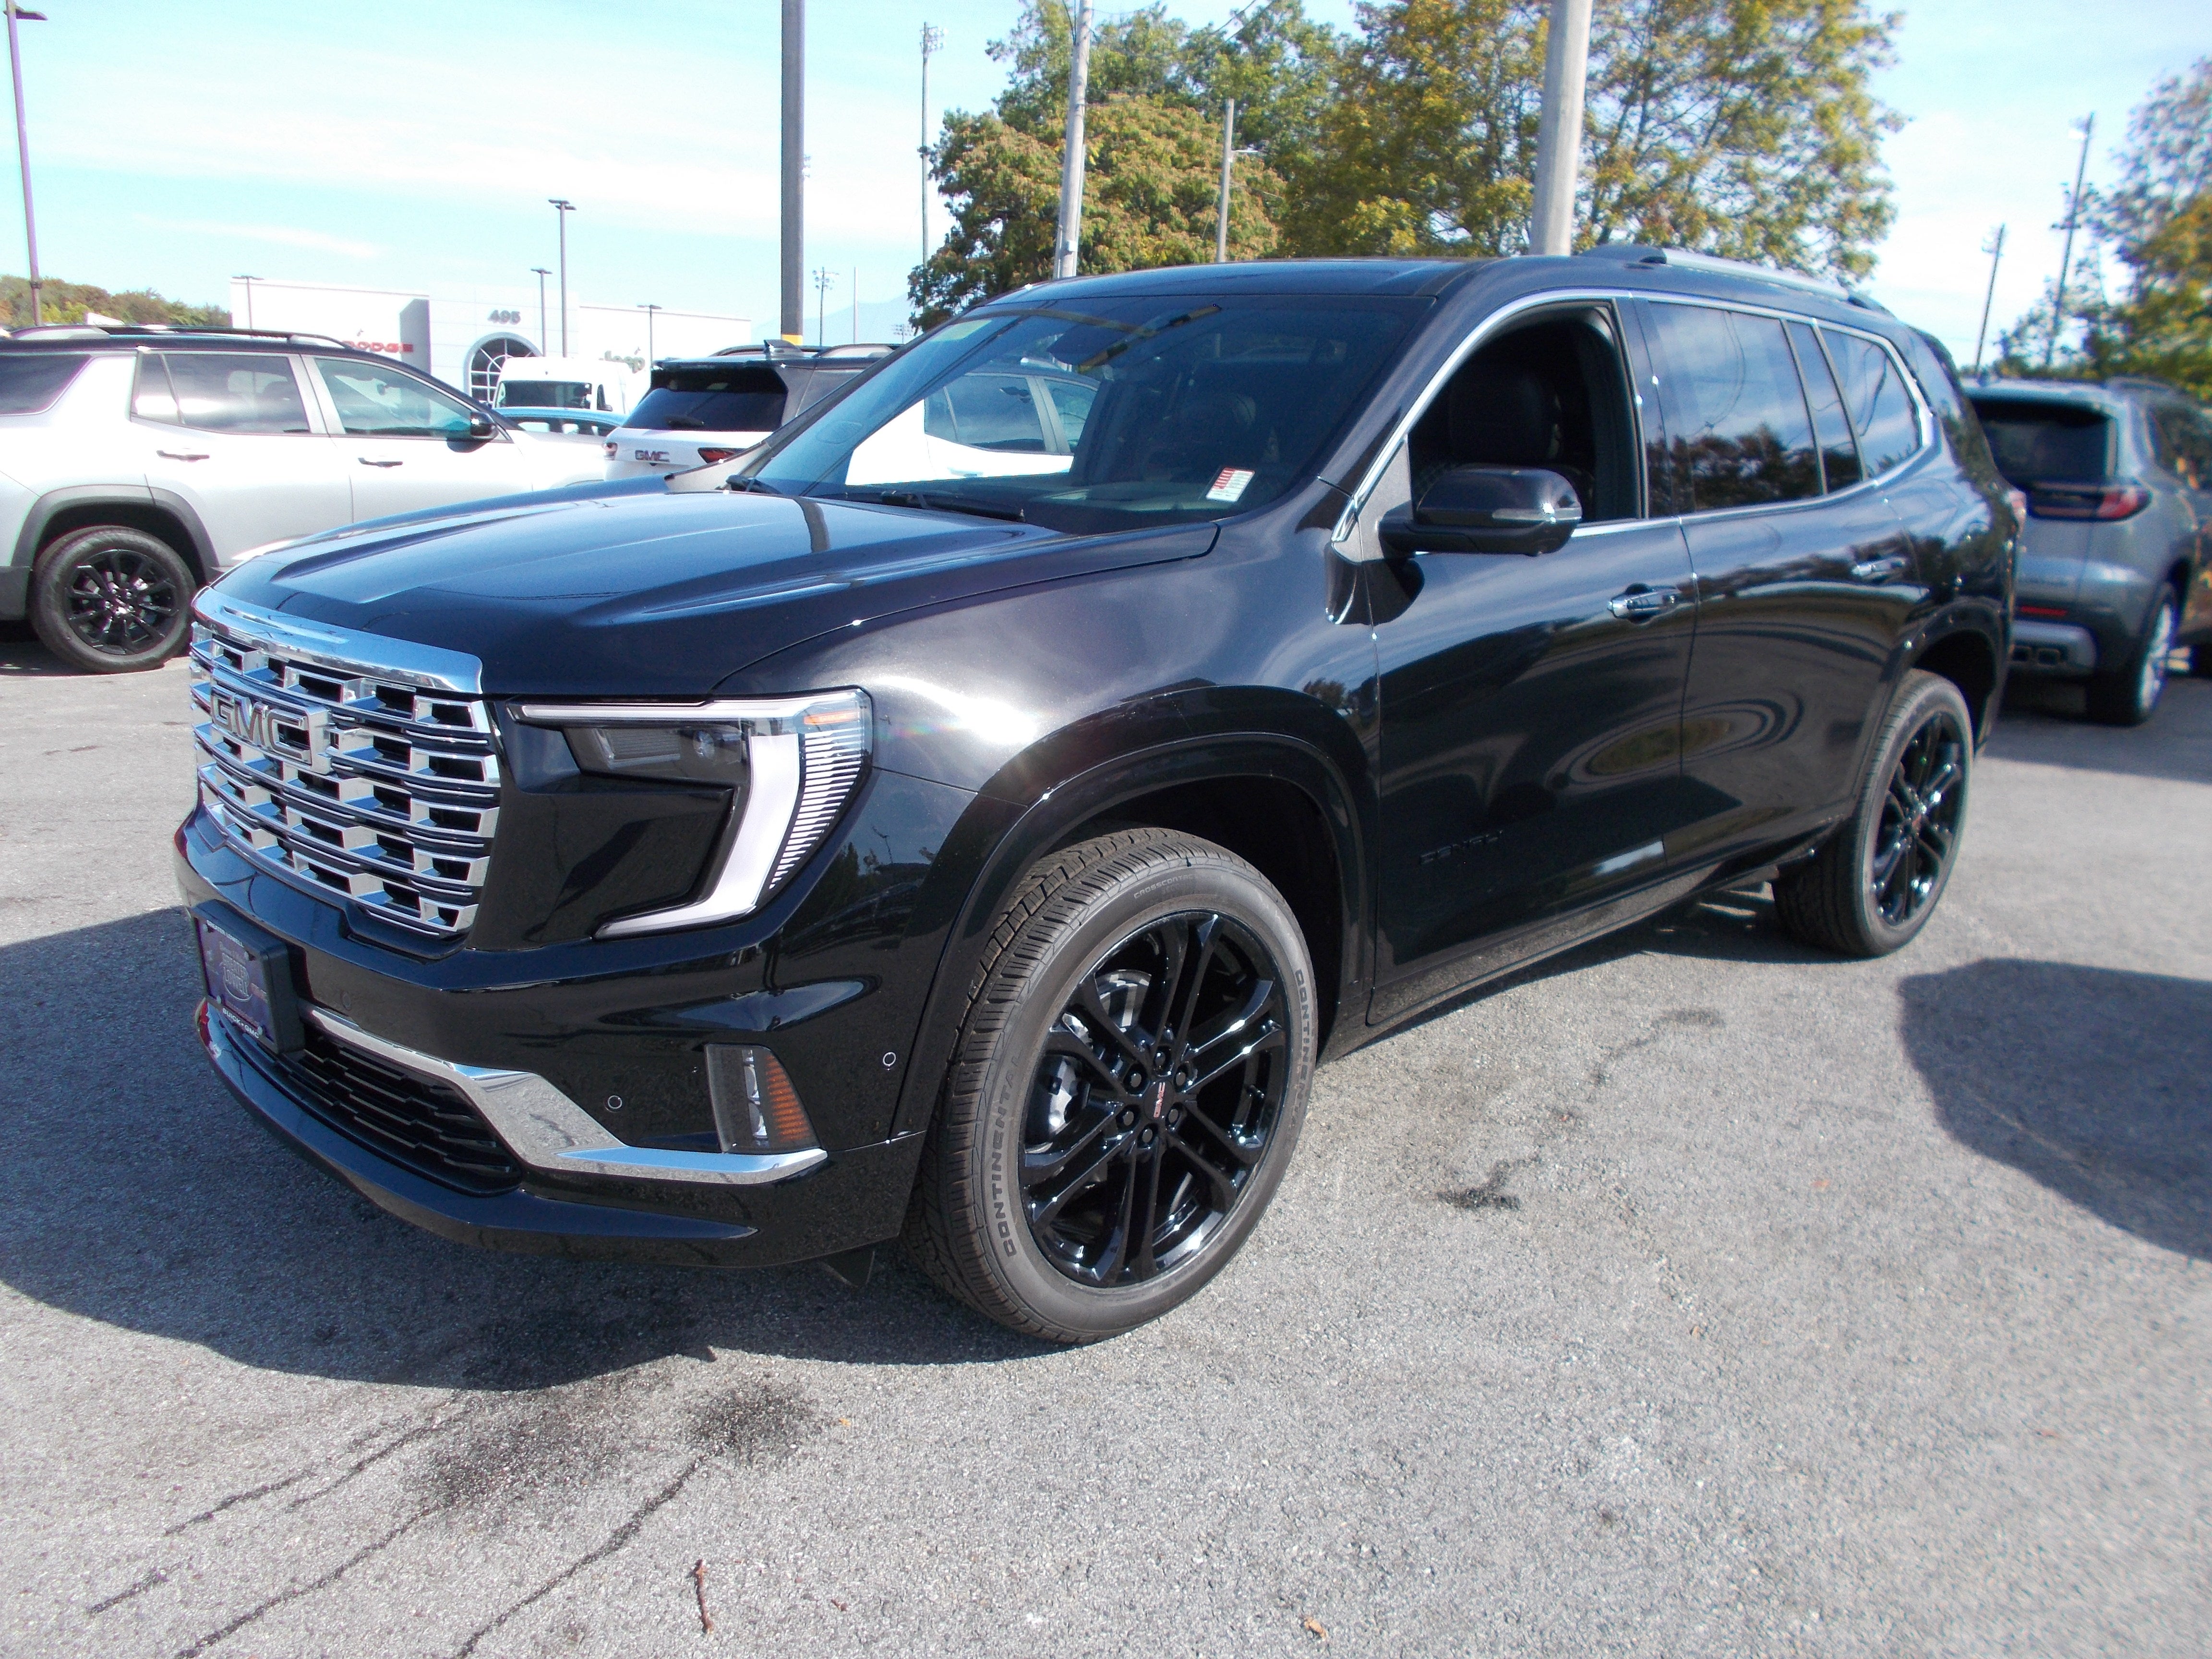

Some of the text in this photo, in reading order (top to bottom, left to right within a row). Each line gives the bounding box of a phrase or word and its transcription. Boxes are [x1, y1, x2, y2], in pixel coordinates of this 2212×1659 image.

[487, 310, 521, 325] 495
[635, 450, 671, 462] GMC
[211, 685, 306, 760] GMC
[1134, 874, 1198, 899] CROSSCONTAC
[222, 1008, 241, 1024] BUICK
[1154, 1082, 1166, 1118] GMC
